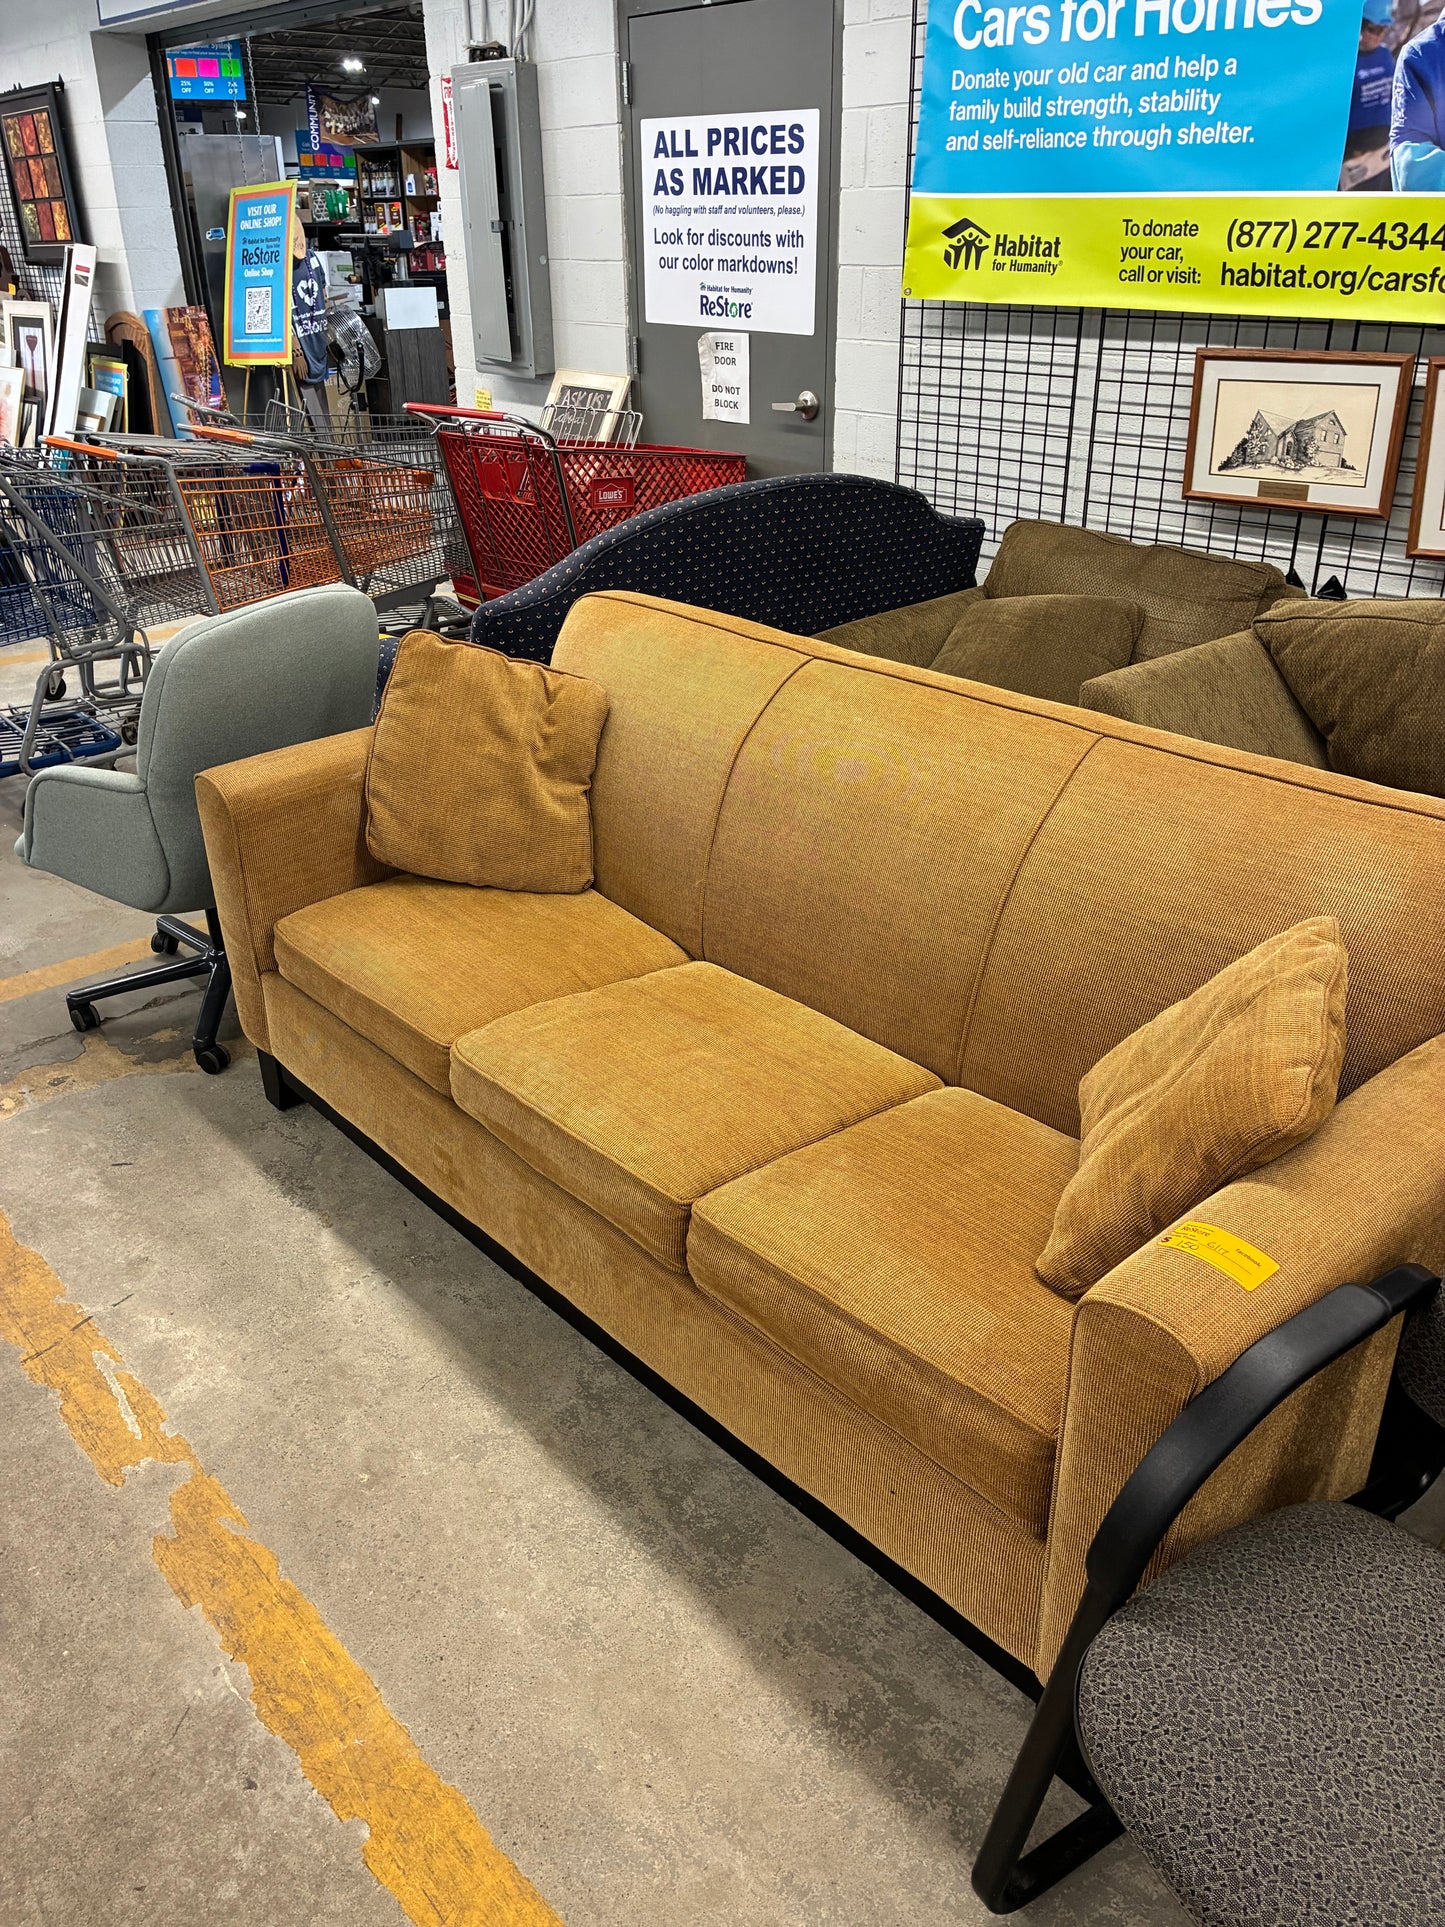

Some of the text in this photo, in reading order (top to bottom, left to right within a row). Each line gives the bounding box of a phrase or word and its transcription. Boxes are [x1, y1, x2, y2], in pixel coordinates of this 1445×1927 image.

[953, 0, 1323, 50] Cars for Homes
[951, 53, 1238, 92] Donate your old car and help a
[948, 88, 1221, 124] family build strength, stability
[307, 86, 320, 151] COMMUNITY
[653, 123, 805, 158] ALL PRICES
[945, 121, 1255, 151] and self-reliance through shelter.
[653, 165, 806, 196] AS MARKED
[247, 204, 277, 217] VISIT OUR
[653, 205, 806, 217] (No haggling with staff and volunteers, please.)
[240, 216, 282, 230] ONLINE SHOP!
[1122, 218, 1199, 237] To donate
[653, 227, 804, 248] Look for discounts with
[1226, 218, 1445, 253] (877) 277-4344
[993, 233, 1061, 258] Habitat
[1119, 245, 1184, 264] your car,
[241, 247, 280, 266] ReStore
[658, 253, 798, 275] our color markdowns!
[244, 267, 274, 277] Online Shop
[992, 259, 1059, 276] for Humanity
[1118, 265, 1201, 284] call or visit:
[706, 284, 723, 292] Habitat
[700, 294, 752, 319] ReStore
[715, 341, 734, 351] FIRE
[714, 356, 737, 366] DOOR
[561, 389, 586, 406] ASK
[711, 384, 741, 395] DO NOT
[714, 398, 739, 410] BLOCK
[599, 489, 623, 500] LOWE'S
[1176, 1240, 1200, 1251] 150
